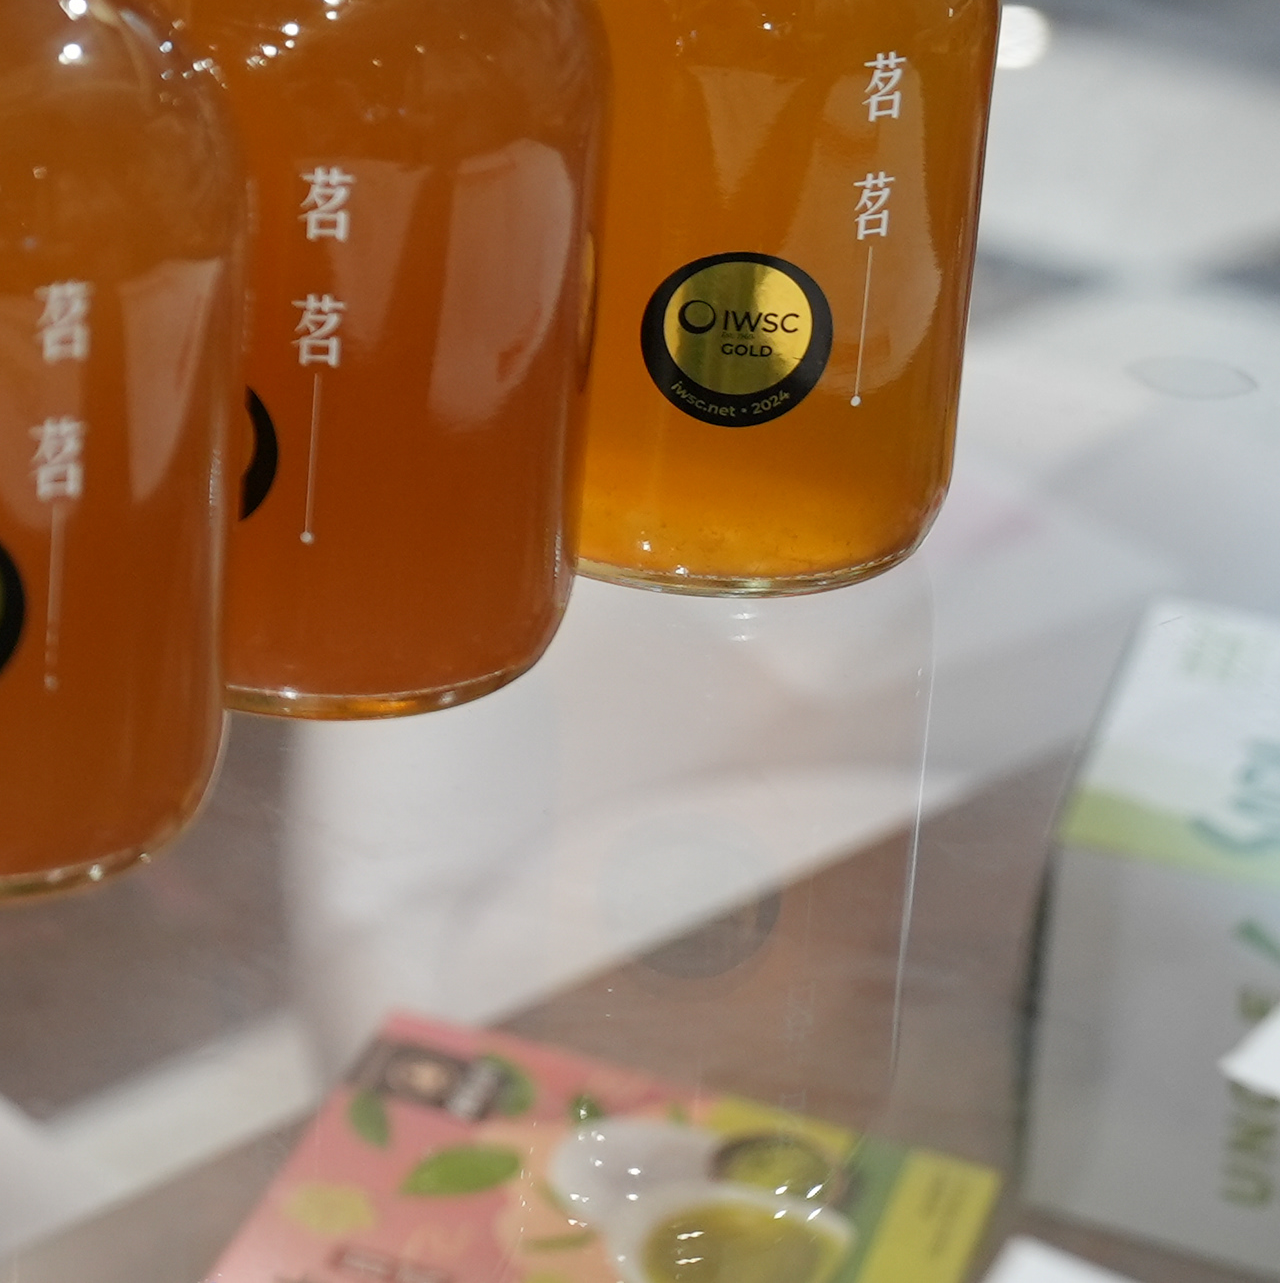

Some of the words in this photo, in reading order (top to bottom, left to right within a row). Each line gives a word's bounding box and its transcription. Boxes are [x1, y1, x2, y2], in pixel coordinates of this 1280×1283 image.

[722, 310, 800, 333] IWSC
[721, 343, 773, 357] GOLD
[670, 381, 736, 417] iwsc.net
[752, 390, 790, 415] 2024
